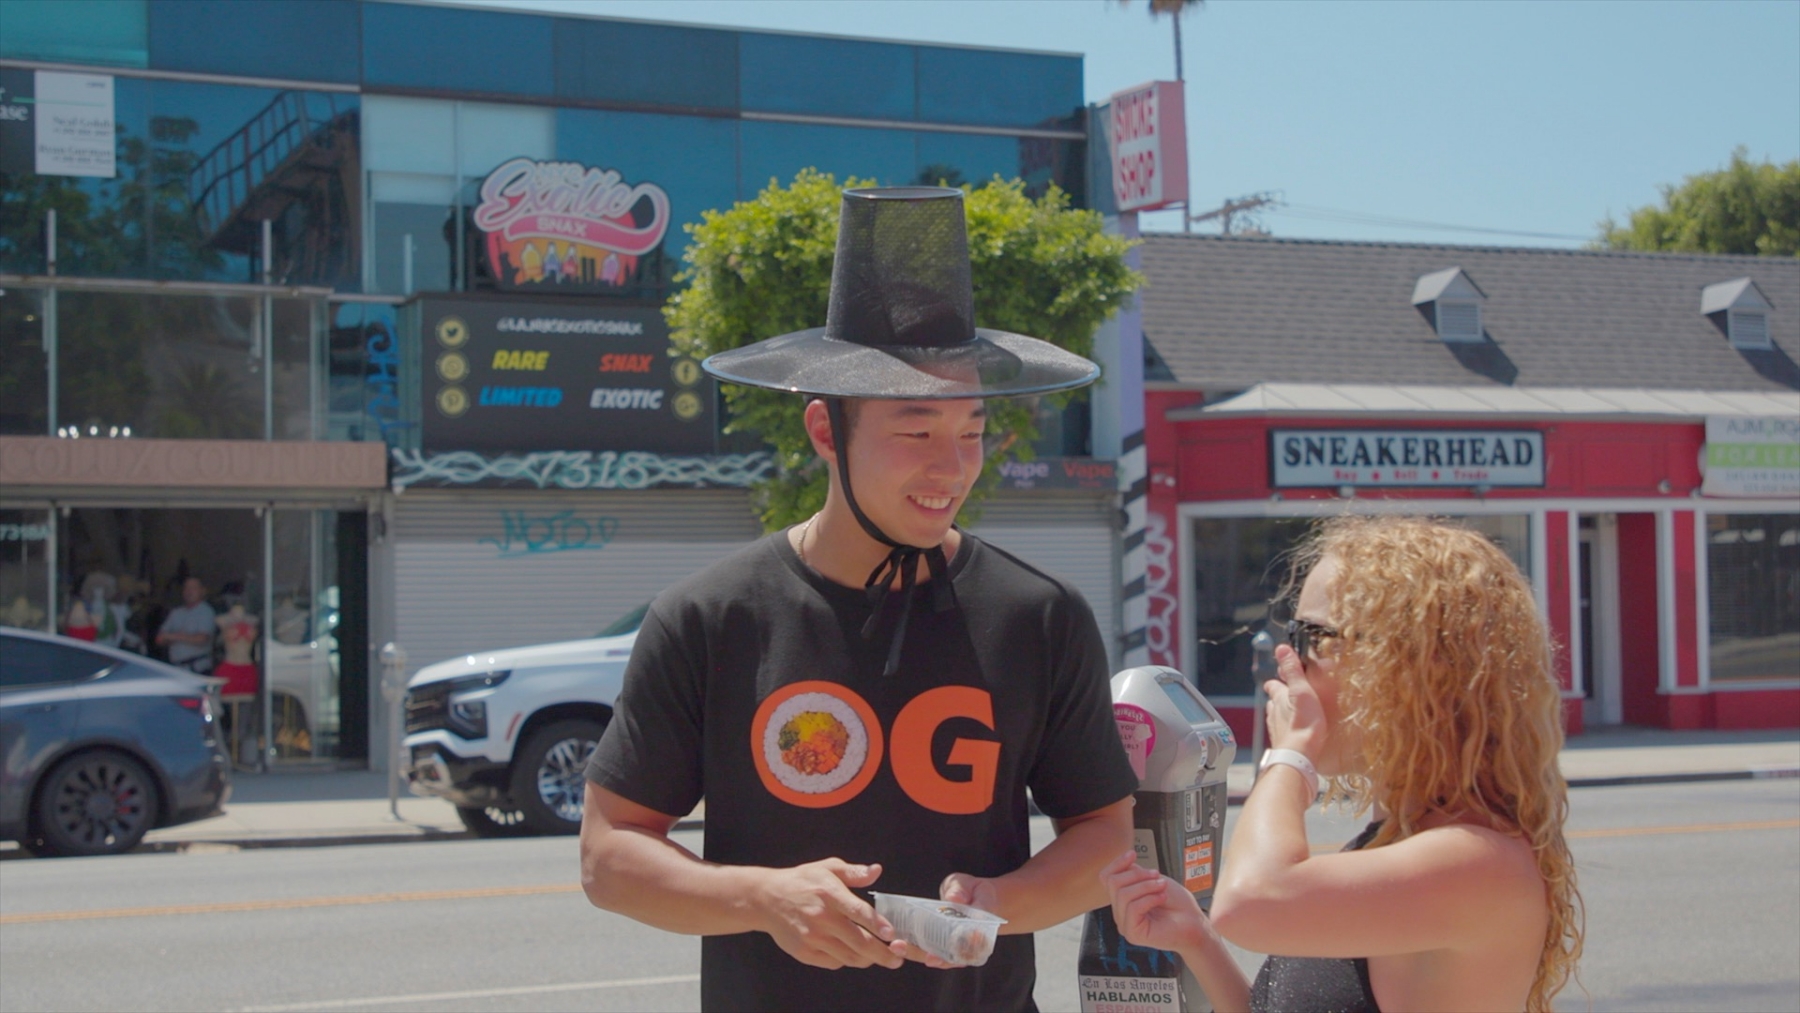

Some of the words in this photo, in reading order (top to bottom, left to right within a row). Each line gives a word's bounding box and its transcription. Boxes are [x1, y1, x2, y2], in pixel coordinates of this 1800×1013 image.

[1117, 89, 1154, 143] SMOKE
[1120, 150, 1154, 202] SHOP
[474, 158, 645, 235] Exotic
[536, 216, 587, 237] SNAX
[492, 350, 550, 371] RARE
[600, 354, 654, 373] SNAX
[479, 386, 563, 407] LIMITED
[590, 388, 664, 409] EXOTIC
[1283, 436, 1534, 468] SNEAKERHEAD
[536, 451, 650, 489] 7318
[997, 460, 1049, 479] Vape
[1062, 461, 1114, 480] Vape
[751, 680, 1001, 814] OG
[1082, 977, 1100, 989] En
[1105, 978, 1127, 990] Los
[1129, 978, 1175, 992] Angeles
[1086, 991, 1172, 1004] HABLAMOS
